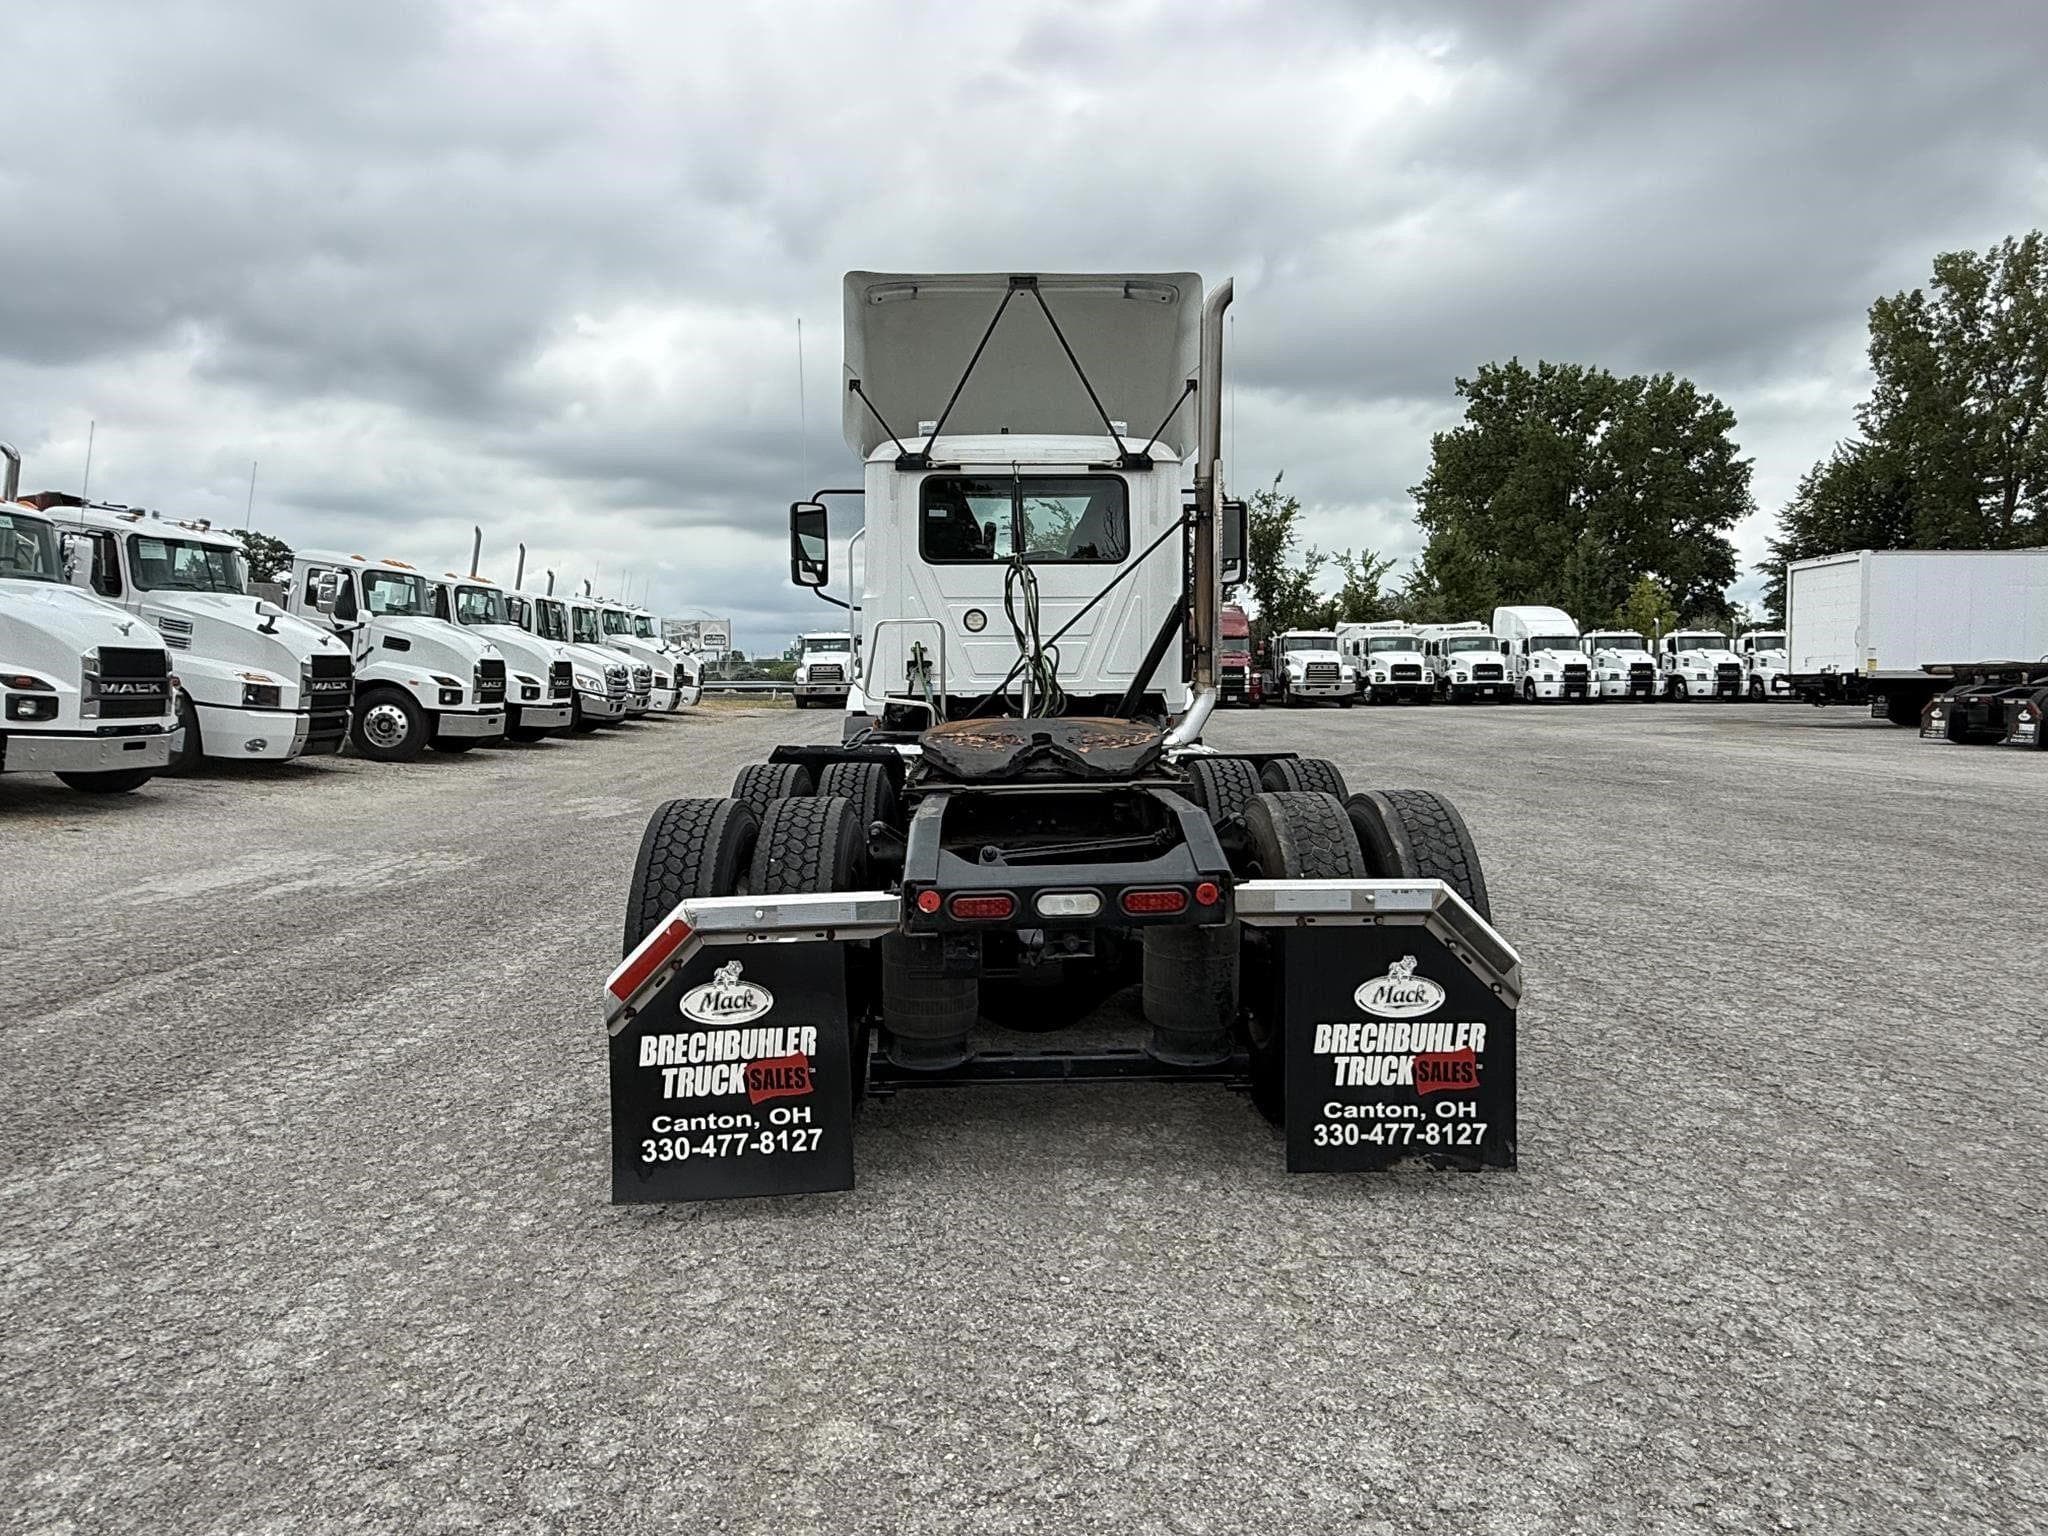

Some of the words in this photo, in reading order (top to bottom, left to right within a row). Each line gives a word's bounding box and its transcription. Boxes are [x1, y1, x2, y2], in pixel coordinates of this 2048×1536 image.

[100, 683, 160, 693] MACK
[312, 682, 347, 690] MACK
[697, 989, 756, 1014] Mack
[1372, 984, 1427, 1005] Mack
[639, 1026, 817, 1067] BRECHBUHLER
[1313, 1023, 1487, 1054] BRECHBUHLER
[662, 1062, 748, 1099] TRUCK
[750, 1066, 806, 1090] SALES
[1334, 1055, 1416, 1086] TRUCK
[1418, 1061, 1473, 1083] SALES
[652, 1112, 761, 1133] Canton,
[769, 1106, 811, 1125] OH
[1323, 1102, 1426, 1120] Canton,
[1435, 1101, 1477, 1118] OH
[641, 1128, 823, 1163] 330-477-8127
[1313, 1122, 1488, 1146] 330-477-8127
